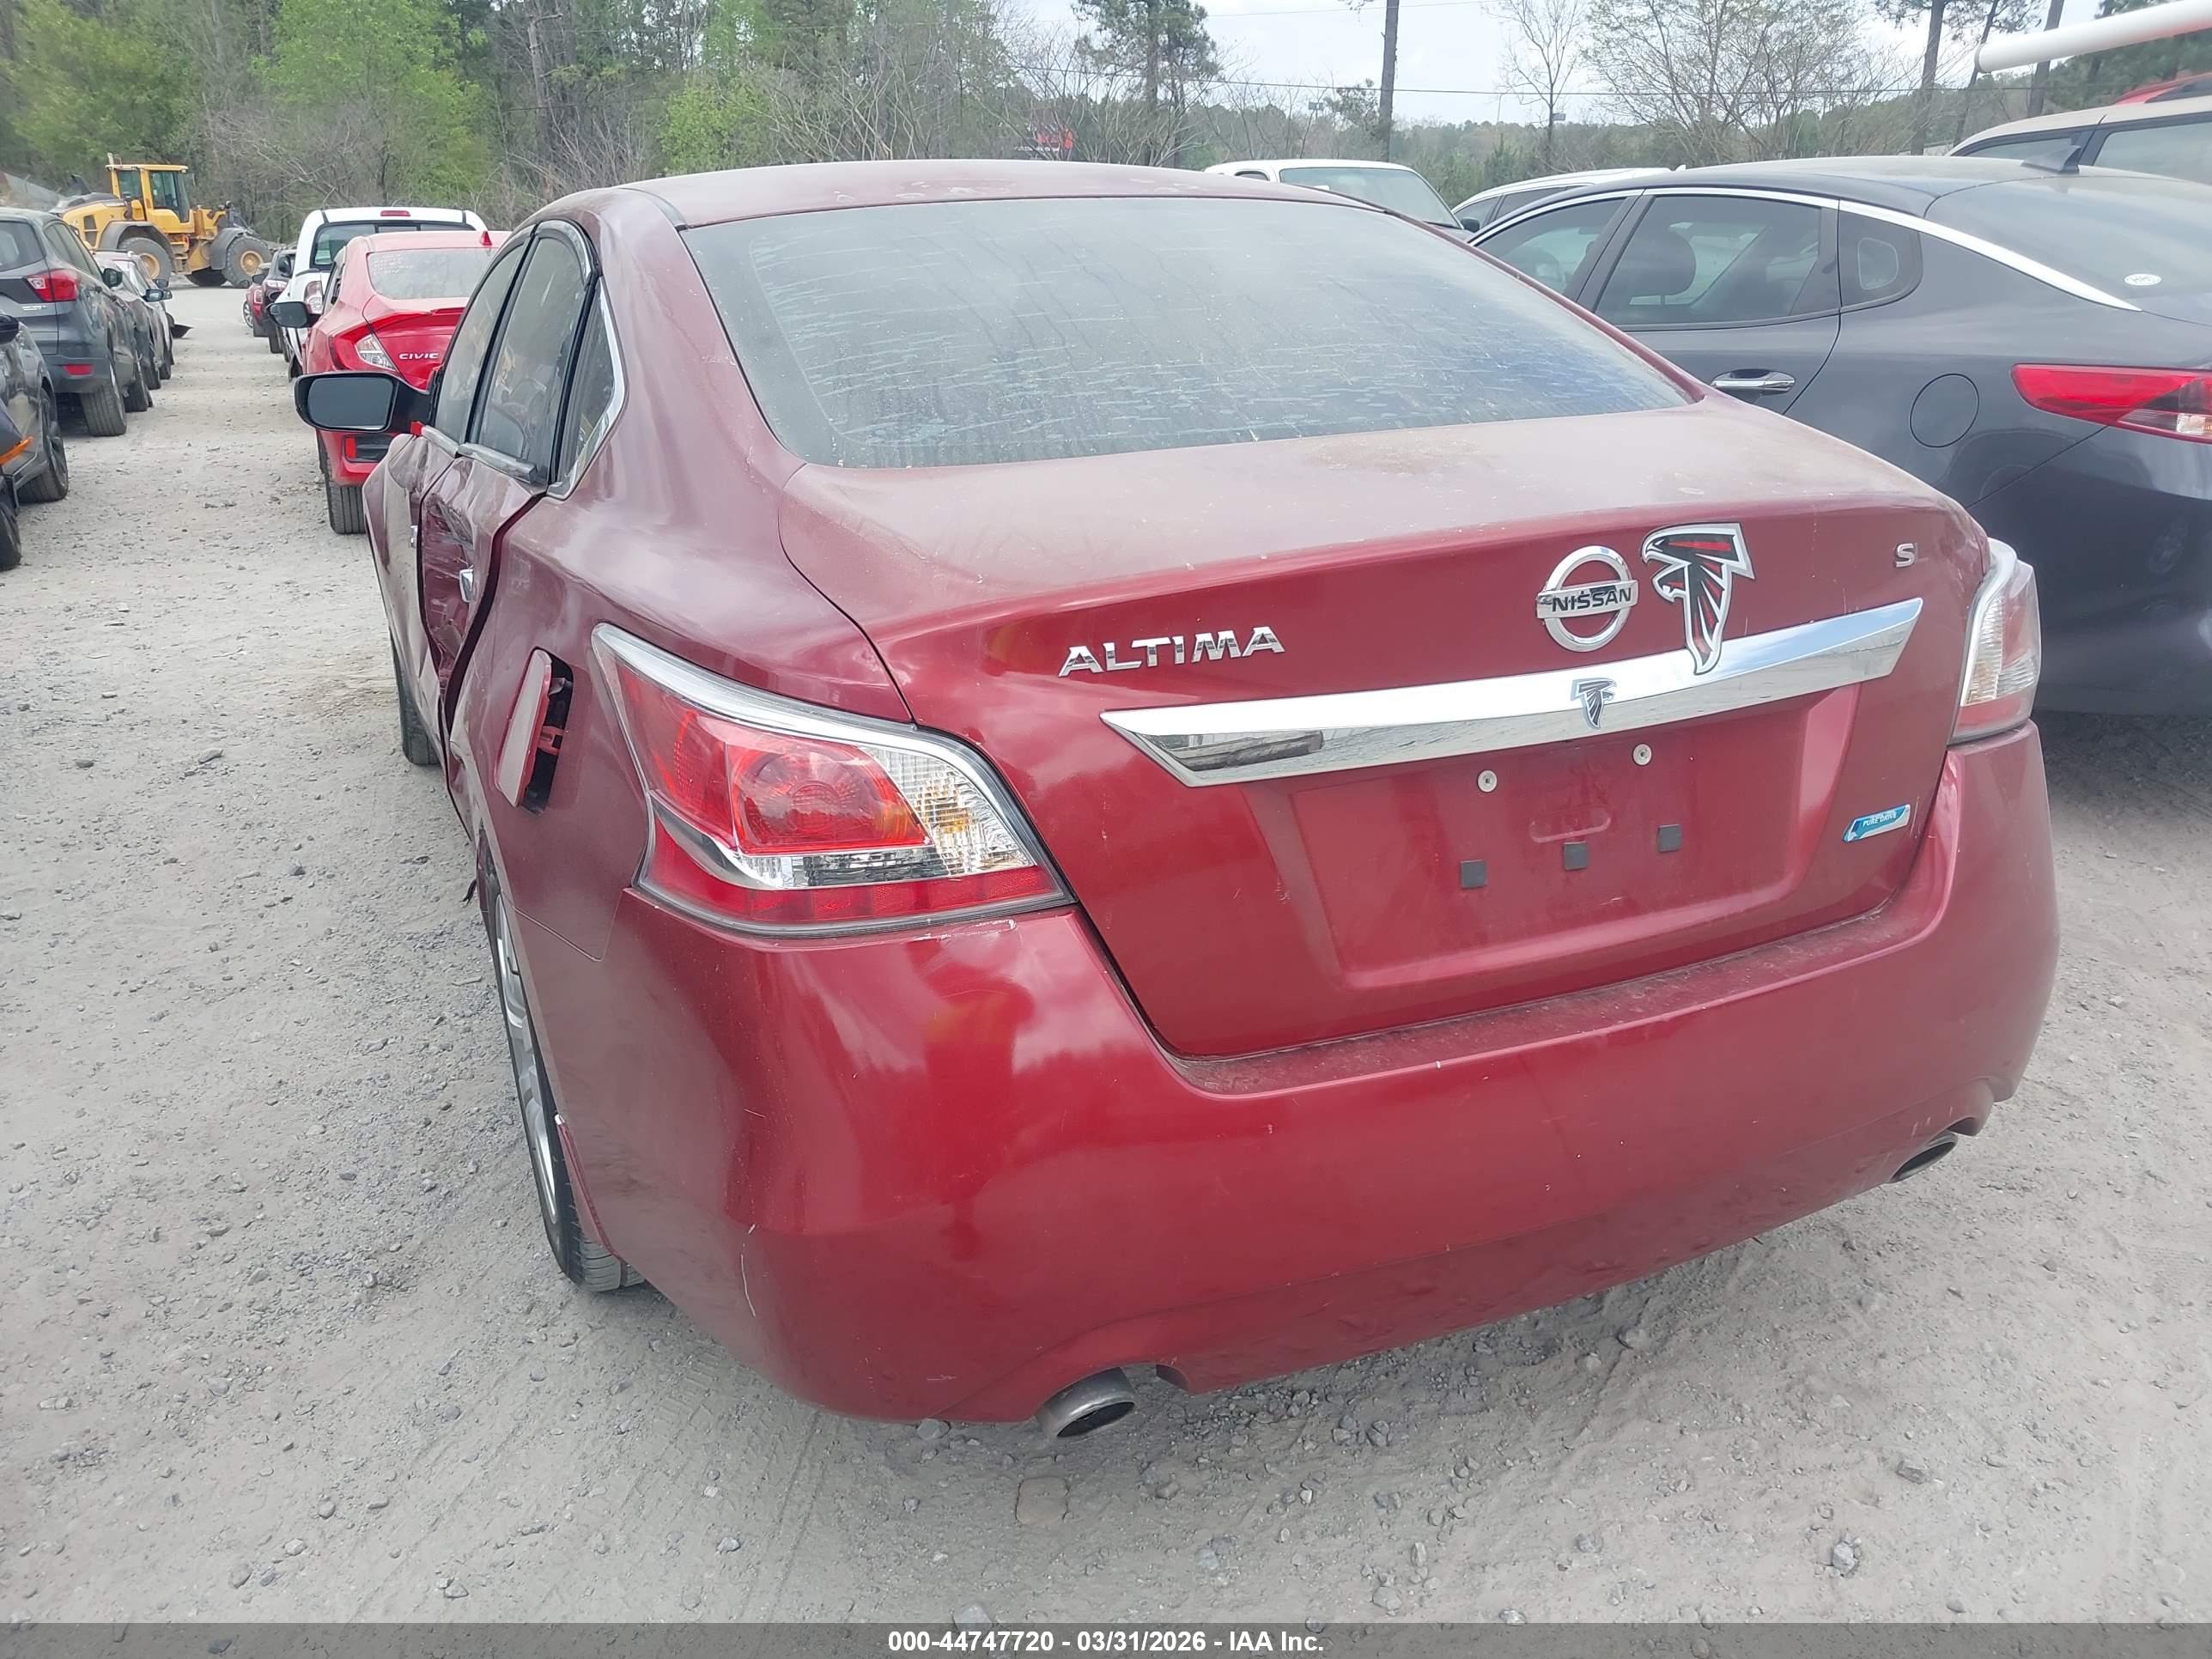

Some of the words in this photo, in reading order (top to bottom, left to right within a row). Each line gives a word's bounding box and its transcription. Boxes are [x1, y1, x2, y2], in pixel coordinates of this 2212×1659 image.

[1895, 543, 1916, 568] S
[1552, 587, 1632, 612] NISSAN
[1058, 626, 1285, 678] ALTIMA
[1863, 817, 1880, 827] PURE
[1880, 812, 1897, 823] DRIVE
